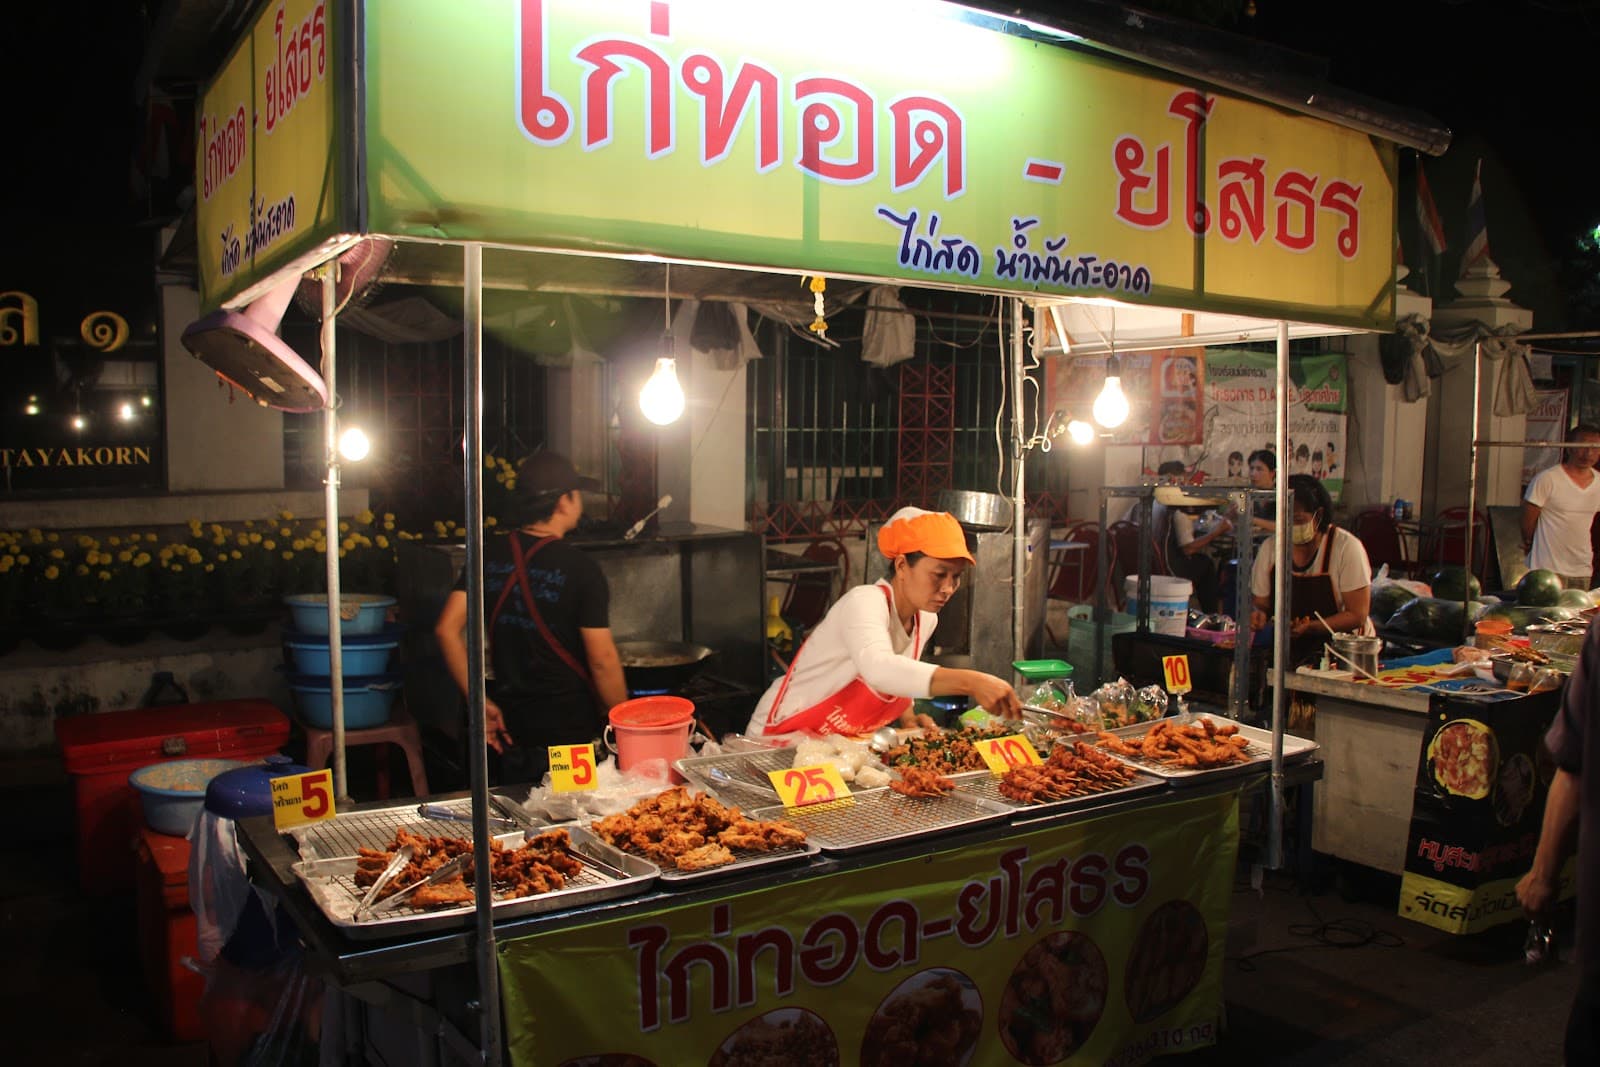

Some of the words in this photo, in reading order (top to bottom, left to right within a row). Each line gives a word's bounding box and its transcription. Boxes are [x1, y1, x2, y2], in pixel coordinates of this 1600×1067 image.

[200, 105, 246, 200] ไก่ทอด
[265, 5, 325, 131] ยโสธร
[1113, 91, 1362, 258] ยโสธร
[877, 207, 980, 275] ไก่สด
[996, 218, 1151, 294] น้ำมันสะอาด
[1, 446, 151, 467] TAYAKORN
[1165, 656, 1187, 686] 10
[571, 746, 592, 785] 5
[990, 739, 1033, 767] 10
[301, 774, 329, 818] 5
[784, 768, 836, 806] 25
